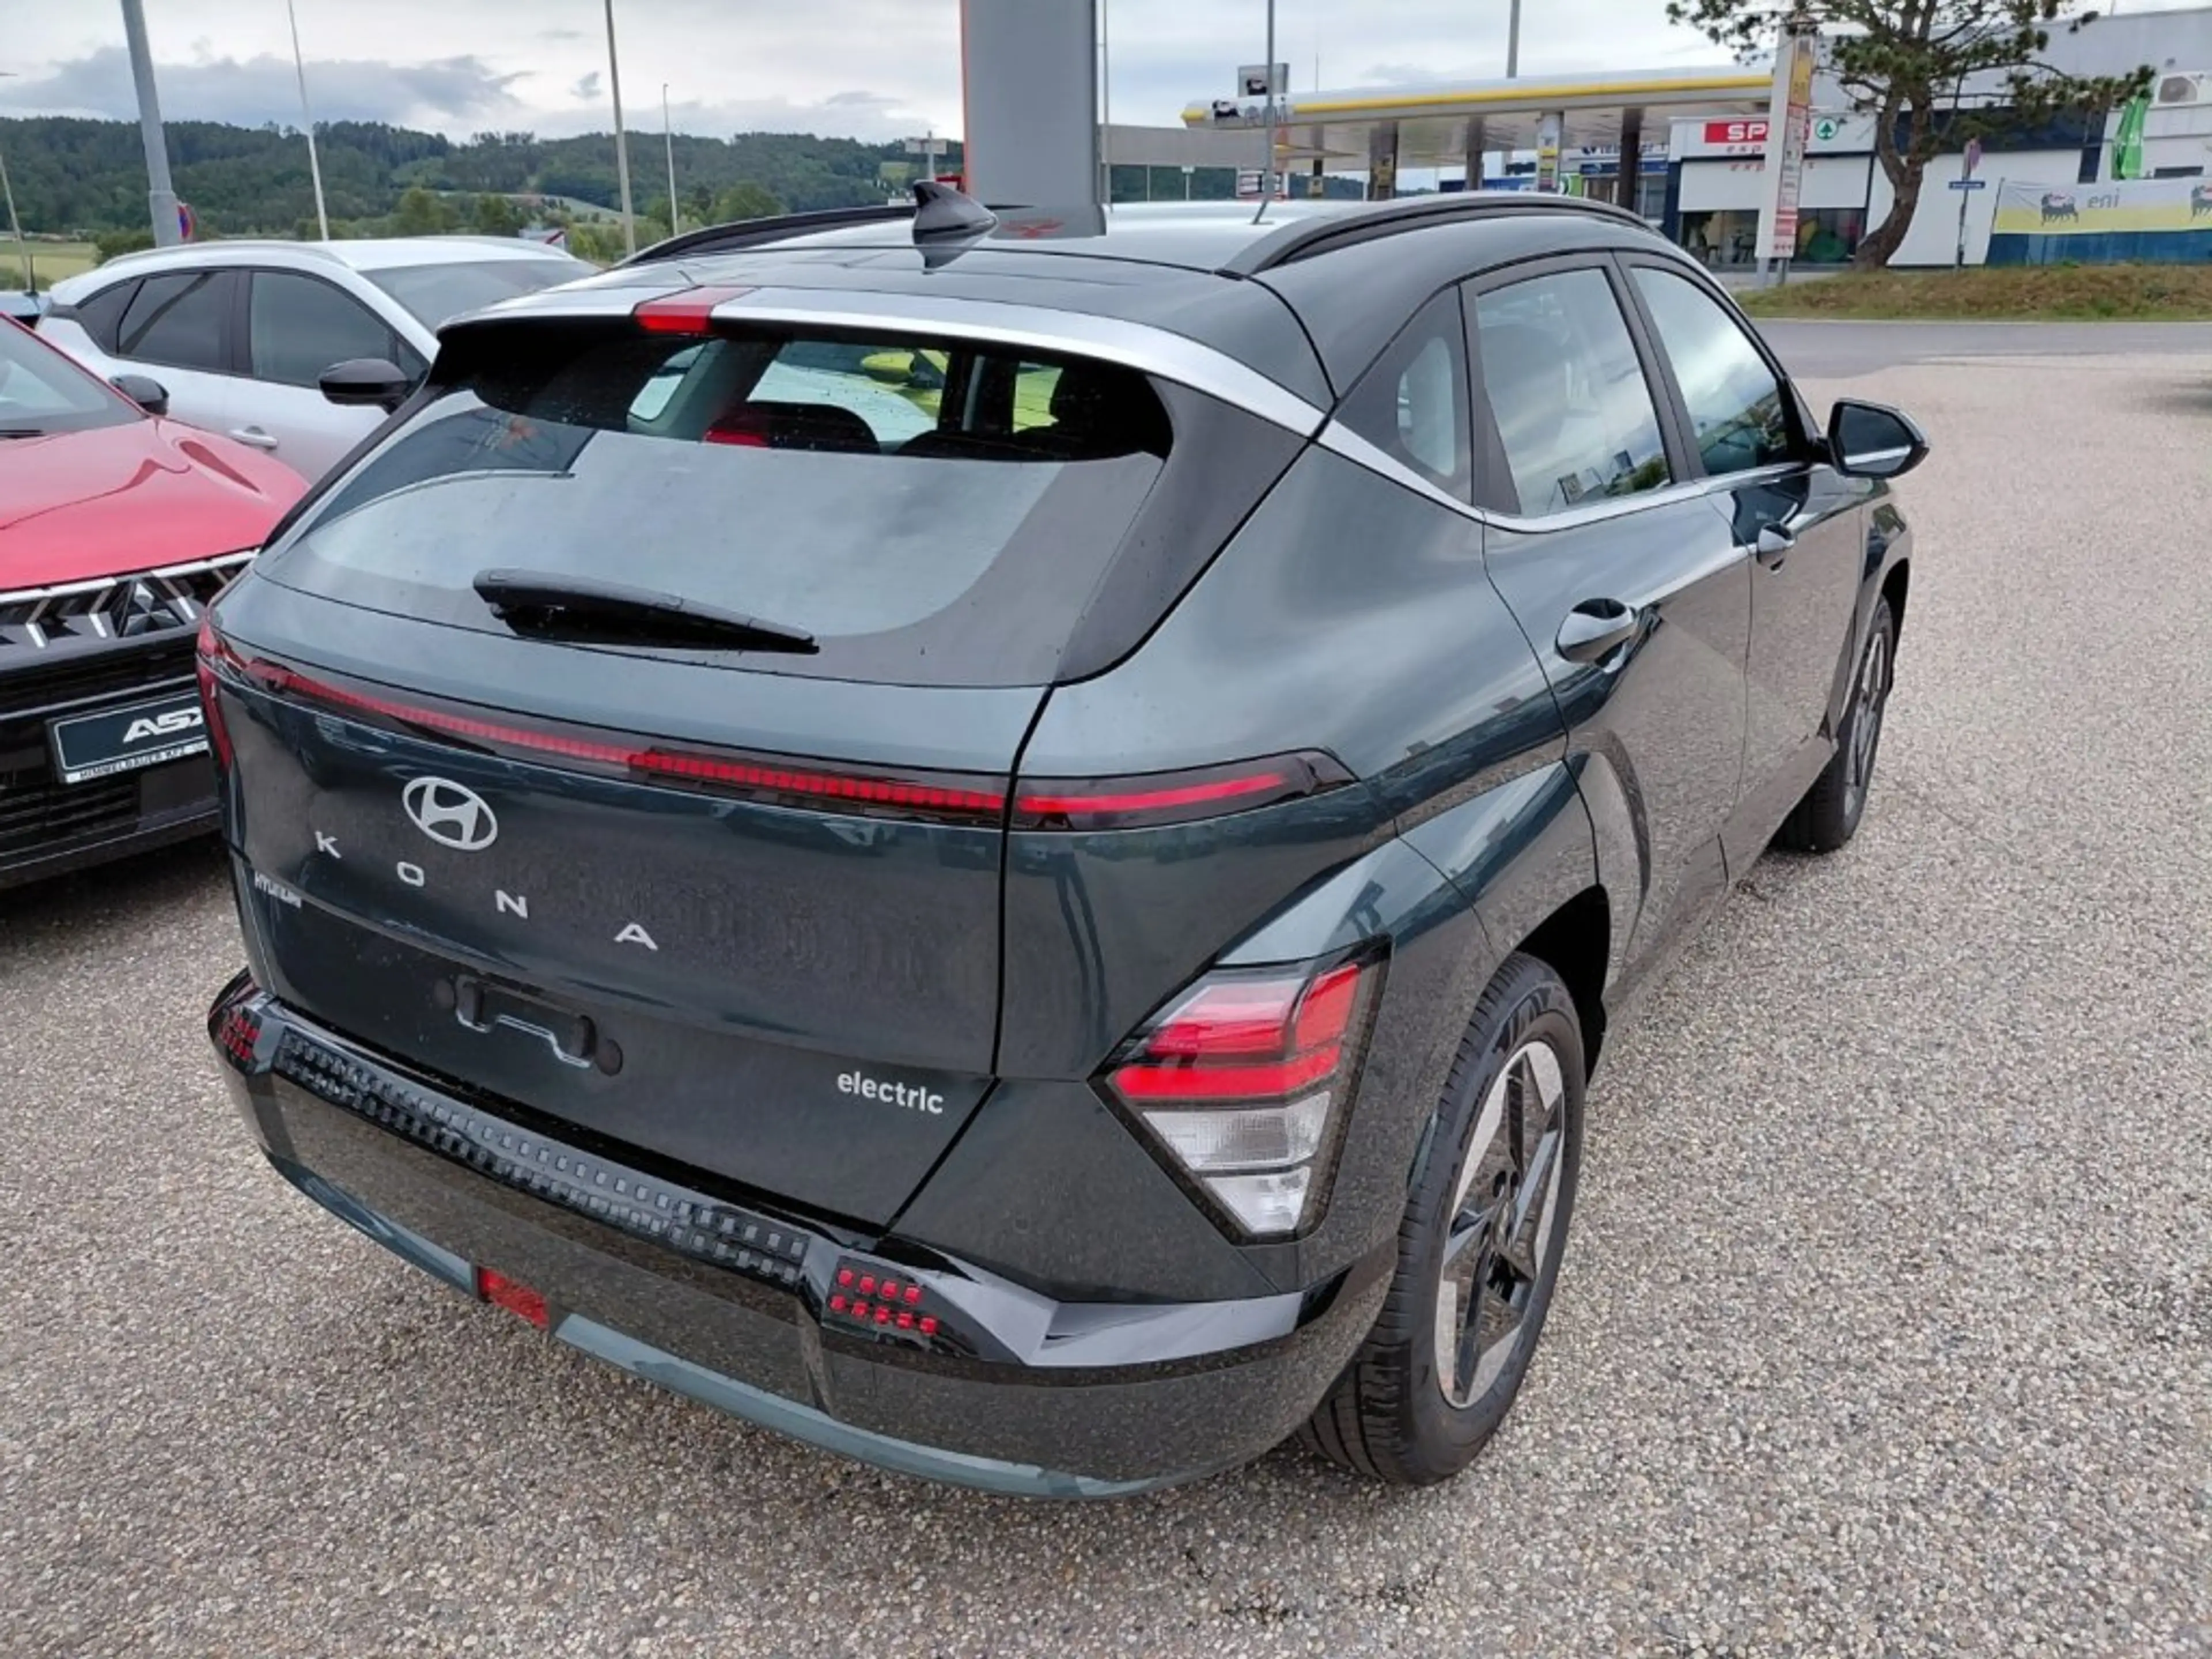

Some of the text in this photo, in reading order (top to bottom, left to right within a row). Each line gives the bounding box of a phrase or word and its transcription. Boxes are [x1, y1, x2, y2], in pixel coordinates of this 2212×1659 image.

[2087, 188, 2120, 209] eni
[315, 831, 658, 950] KONA
[837, 1071, 944, 1114] electric
